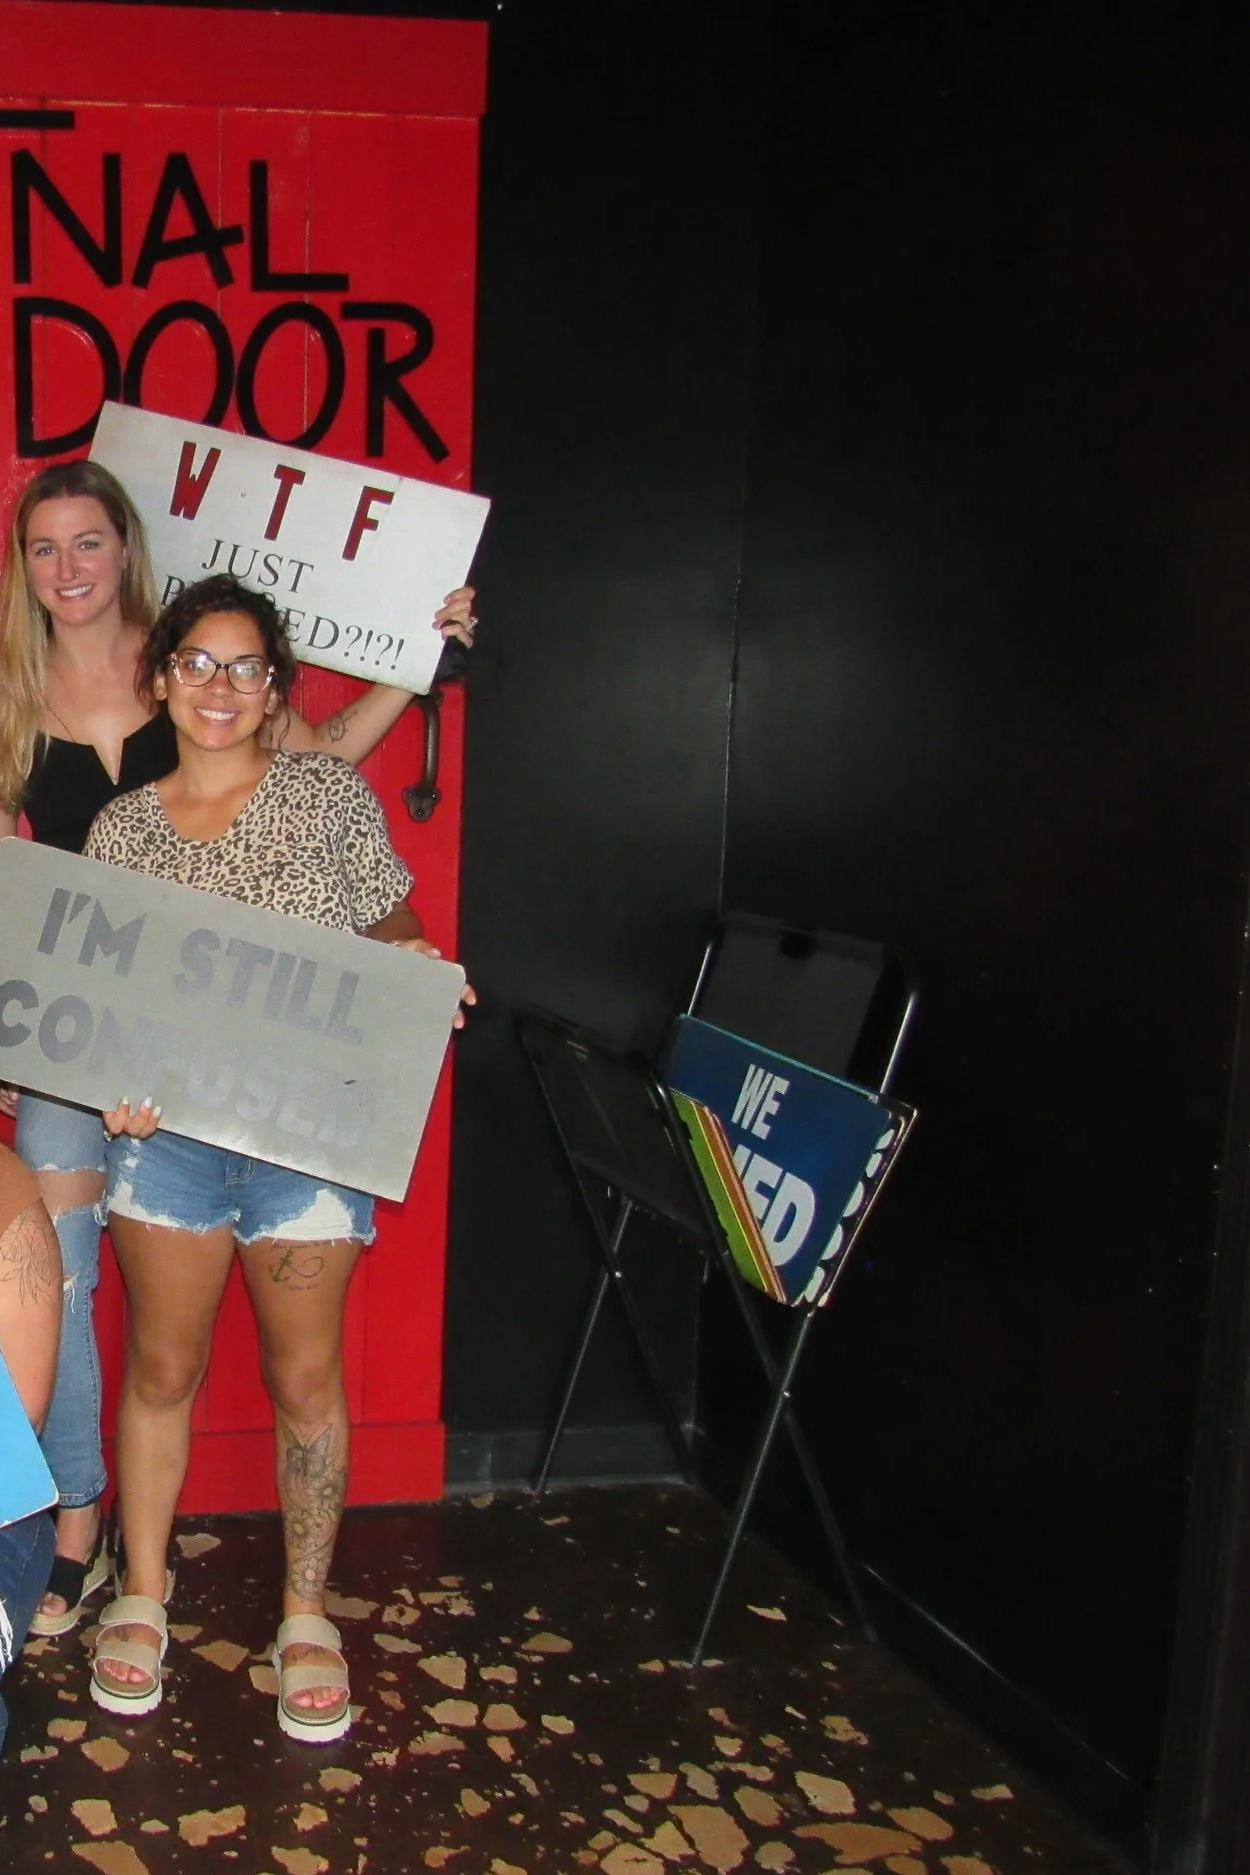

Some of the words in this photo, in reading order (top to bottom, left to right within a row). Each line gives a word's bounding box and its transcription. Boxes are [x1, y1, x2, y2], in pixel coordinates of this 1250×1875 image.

[12, 296, 448, 464] DOOR
[202, 539, 314, 593] JUST
[37, 887, 148, 977] I'M
[174, 928, 364, 1046] STILL
[731, 1063, 790, 1140] WE
